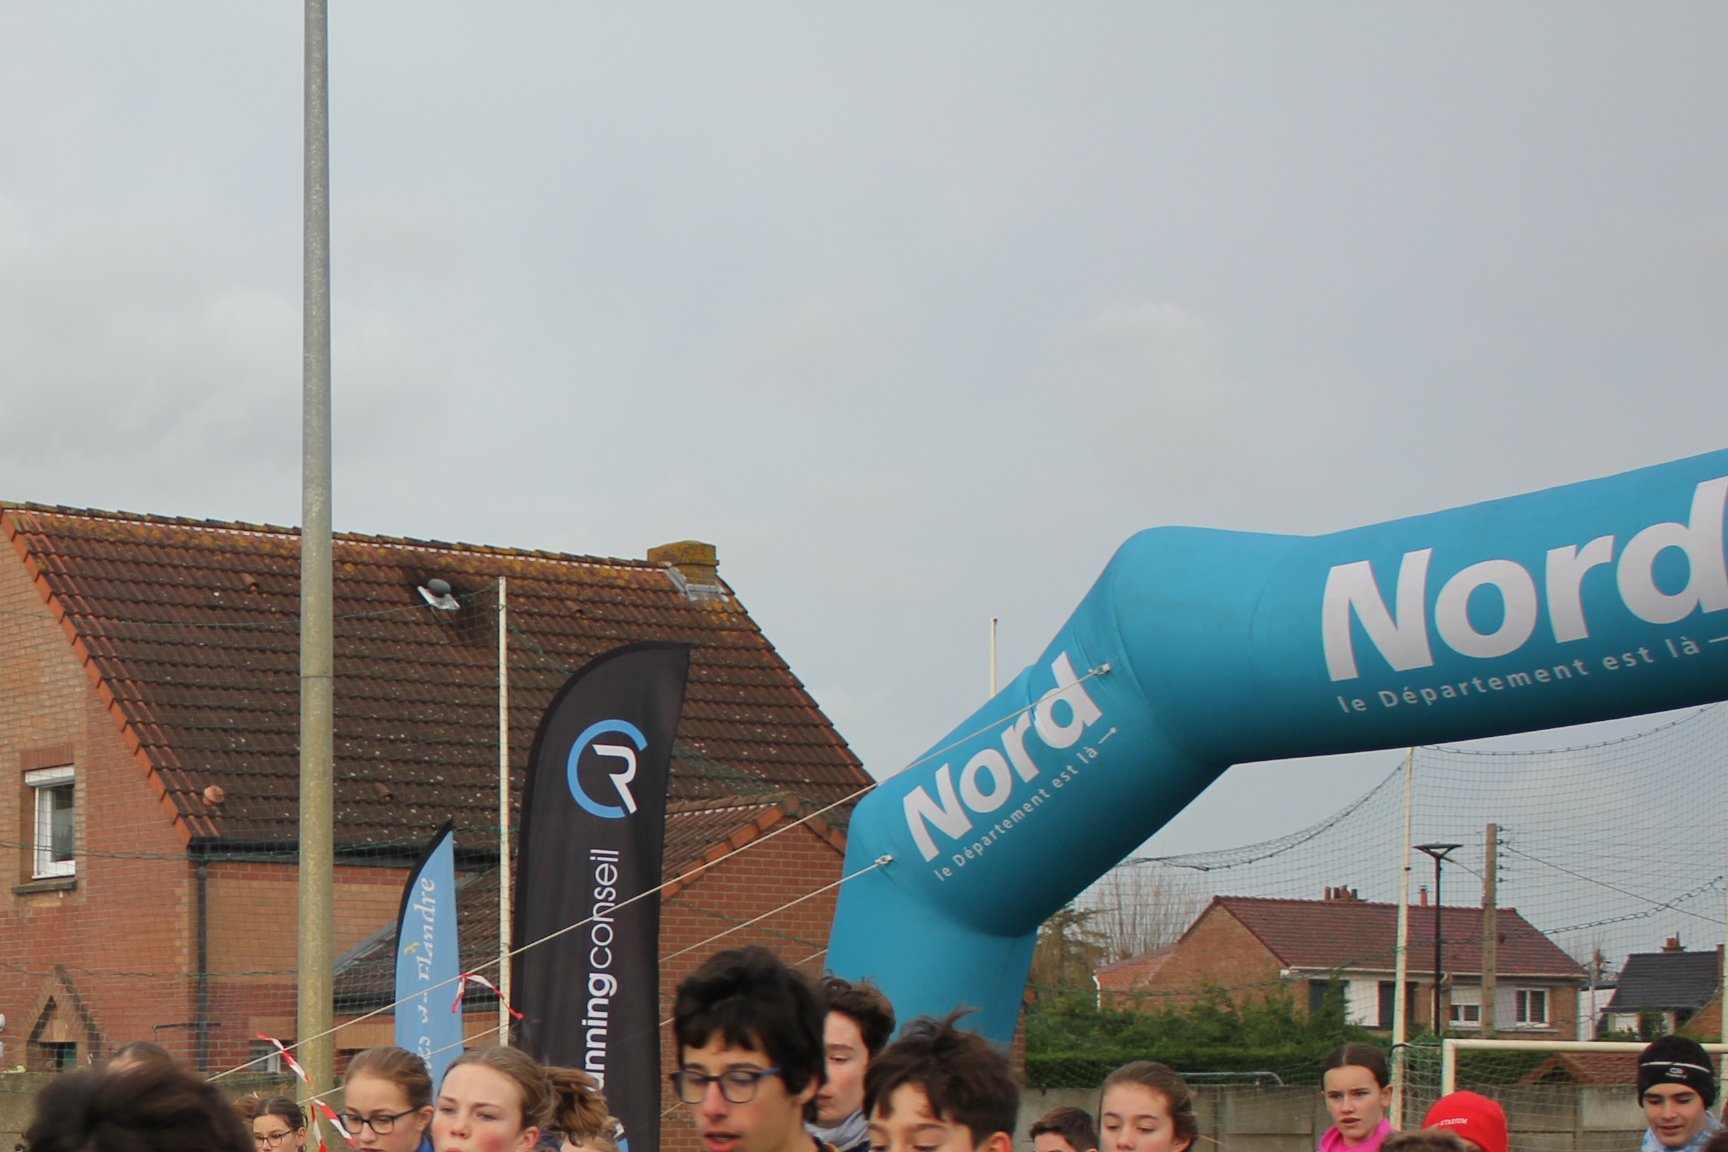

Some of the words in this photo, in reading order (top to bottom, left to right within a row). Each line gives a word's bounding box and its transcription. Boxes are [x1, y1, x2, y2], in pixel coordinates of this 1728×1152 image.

[1322, 475, 1728, 682] Nord
[1338, 694, 1367, 714] le
[1378, 657, 1589, 708] Département
[1602, 644, 1655, 671] est
[1665, 635, 1700, 659] là
[903, 651, 1103, 863] Nord
[934, 865, 953, 882] le
[952, 787, 1052, 867] Département
[1051, 763, 1079, 789] est
[1076, 746, 1099, 765] là
[581, 848, 620, 1092] unningconseil
